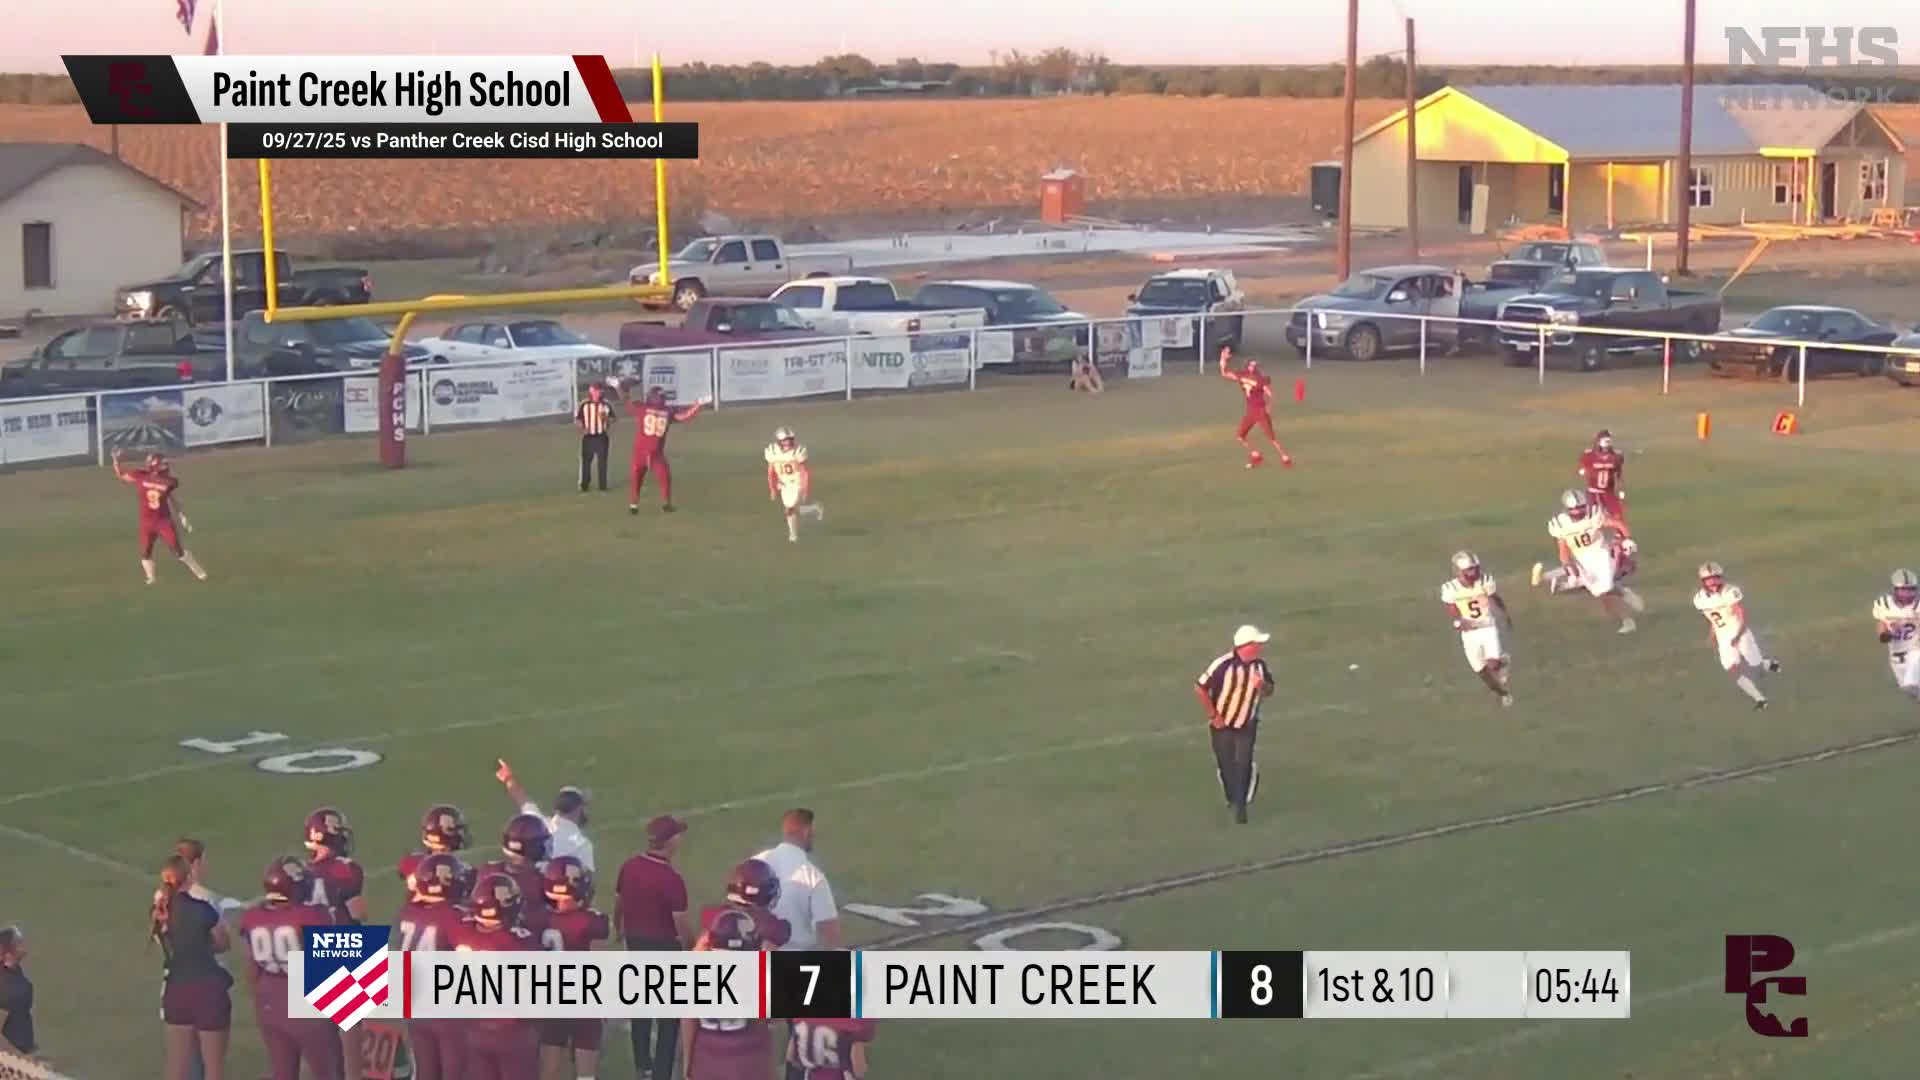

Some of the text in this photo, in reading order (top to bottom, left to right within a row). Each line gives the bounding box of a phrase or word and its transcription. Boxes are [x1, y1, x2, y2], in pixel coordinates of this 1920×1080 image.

[391, 381, 405, 442] PCHS
[643, 413, 668, 437] 99
[1467, 600, 1482, 619] 5
[1710, 611, 1726, 629] 2
[178, 730, 384, 775] 10
[794, 1020, 839, 1069] 16
